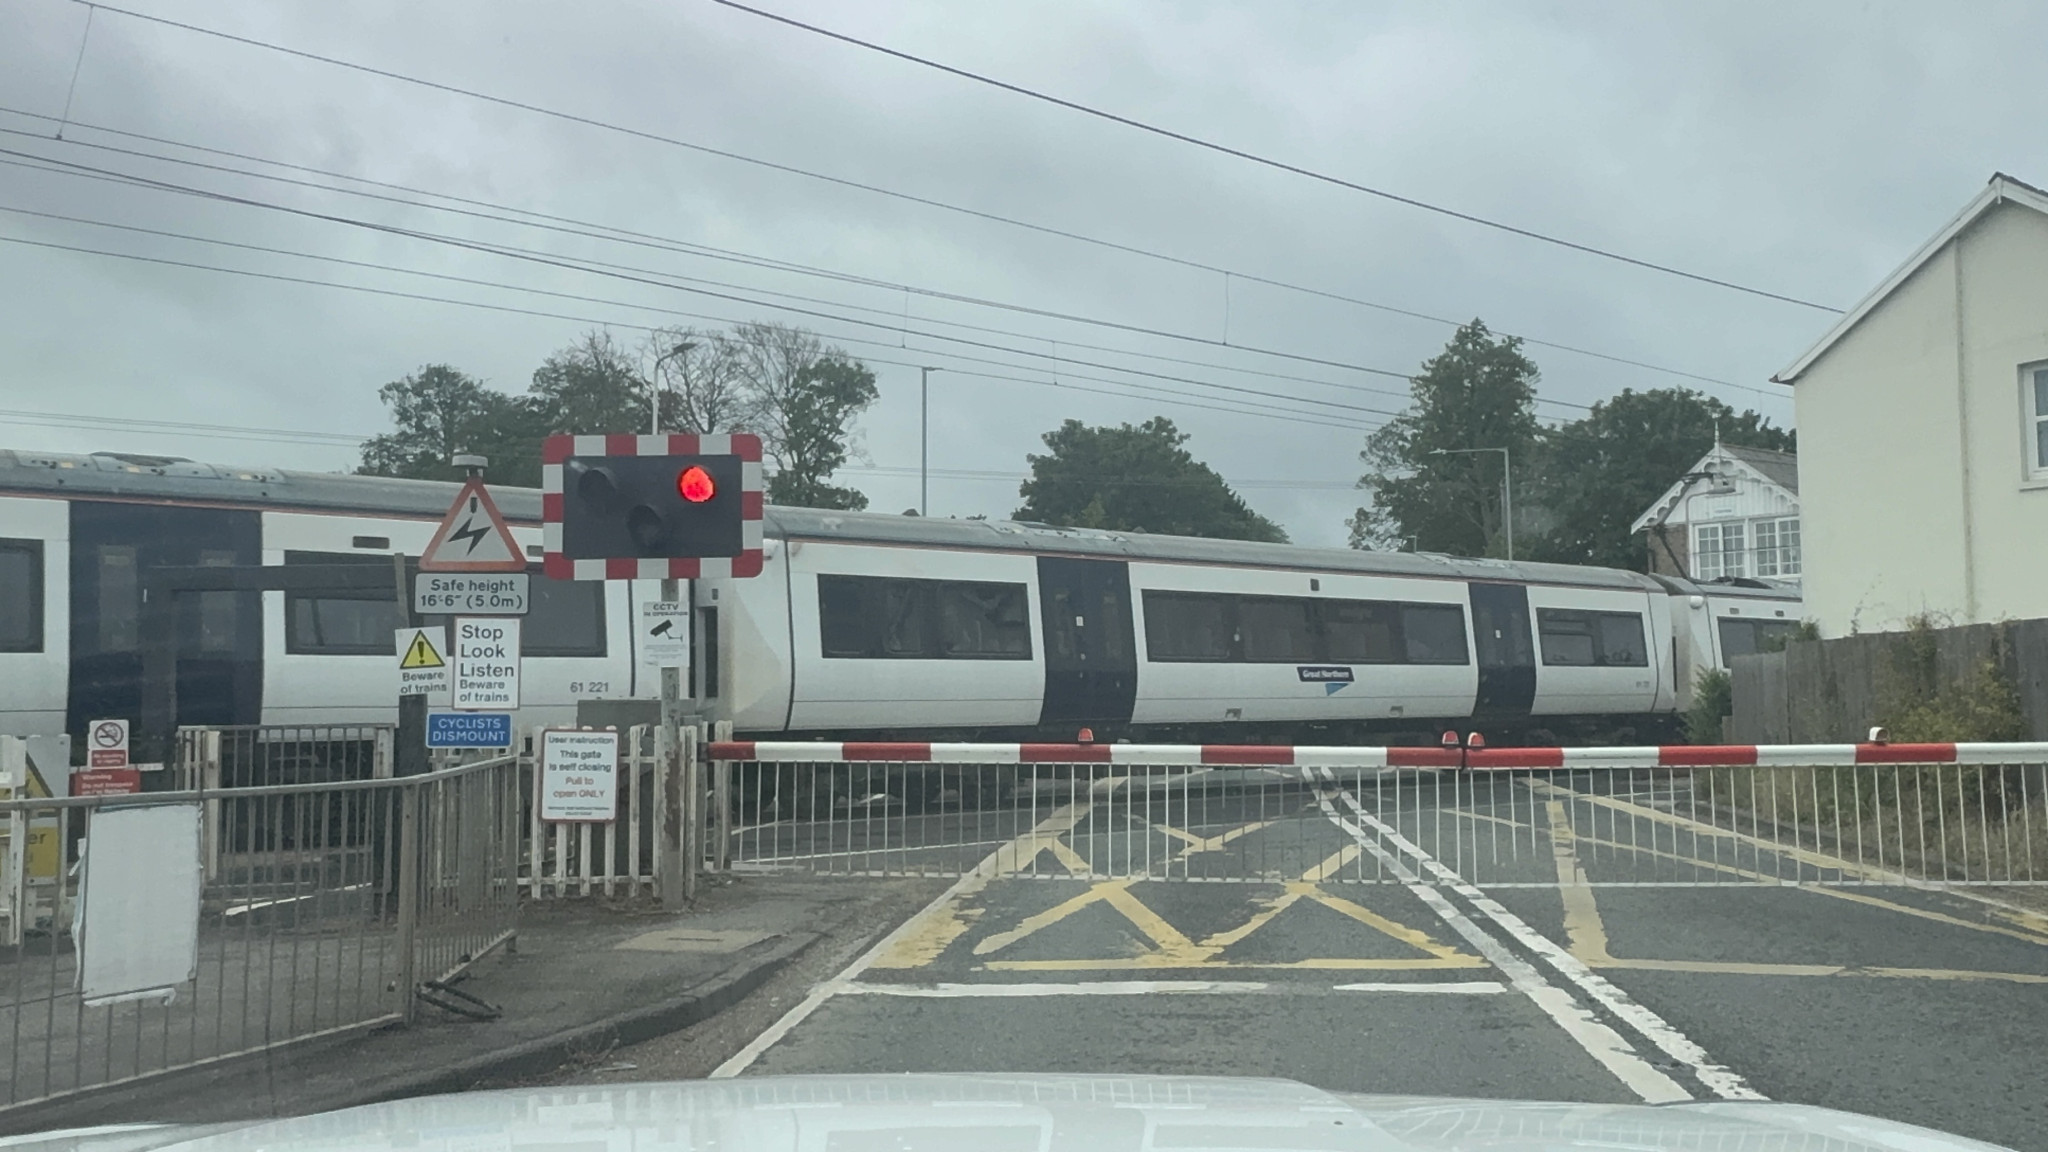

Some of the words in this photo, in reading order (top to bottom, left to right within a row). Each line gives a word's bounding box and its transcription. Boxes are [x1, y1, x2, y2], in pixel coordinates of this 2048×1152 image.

[430, 579, 464, 591] Safe
[469, 579, 515, 593] height
[653, 603, 679, 611] CCTV
[461, 624, 504, 642] Stop
[461, 643, 505, 658] Look
[460, 662, 515, 677] Listen
[402, 671, 445, 682] Beware
[400, 684, 412, 694] of
[415, 682, 447, 692] trains
[460, 679, 505, 689] Beware
[570, 681, 584, 693] 61
[589, 681, 609, 693] 221
[459, 692, 471, 702] of
[475, 692, 510, 702] trains
[438, 718, 502, 729] CYCLISTS
[432, 731, 506, 742] DISMOUNT
[560, 750, 579, 759] This
[581, 751, 602, 760] gate
[559, 763, 577, 771] self
[578, 763, 612, 772] closing
[565, 777, 583, 785] Pull
[584, 777, 595, 785] to
[553, 790, 577, 799] open
[579, 789, 605, 798] ONLY
